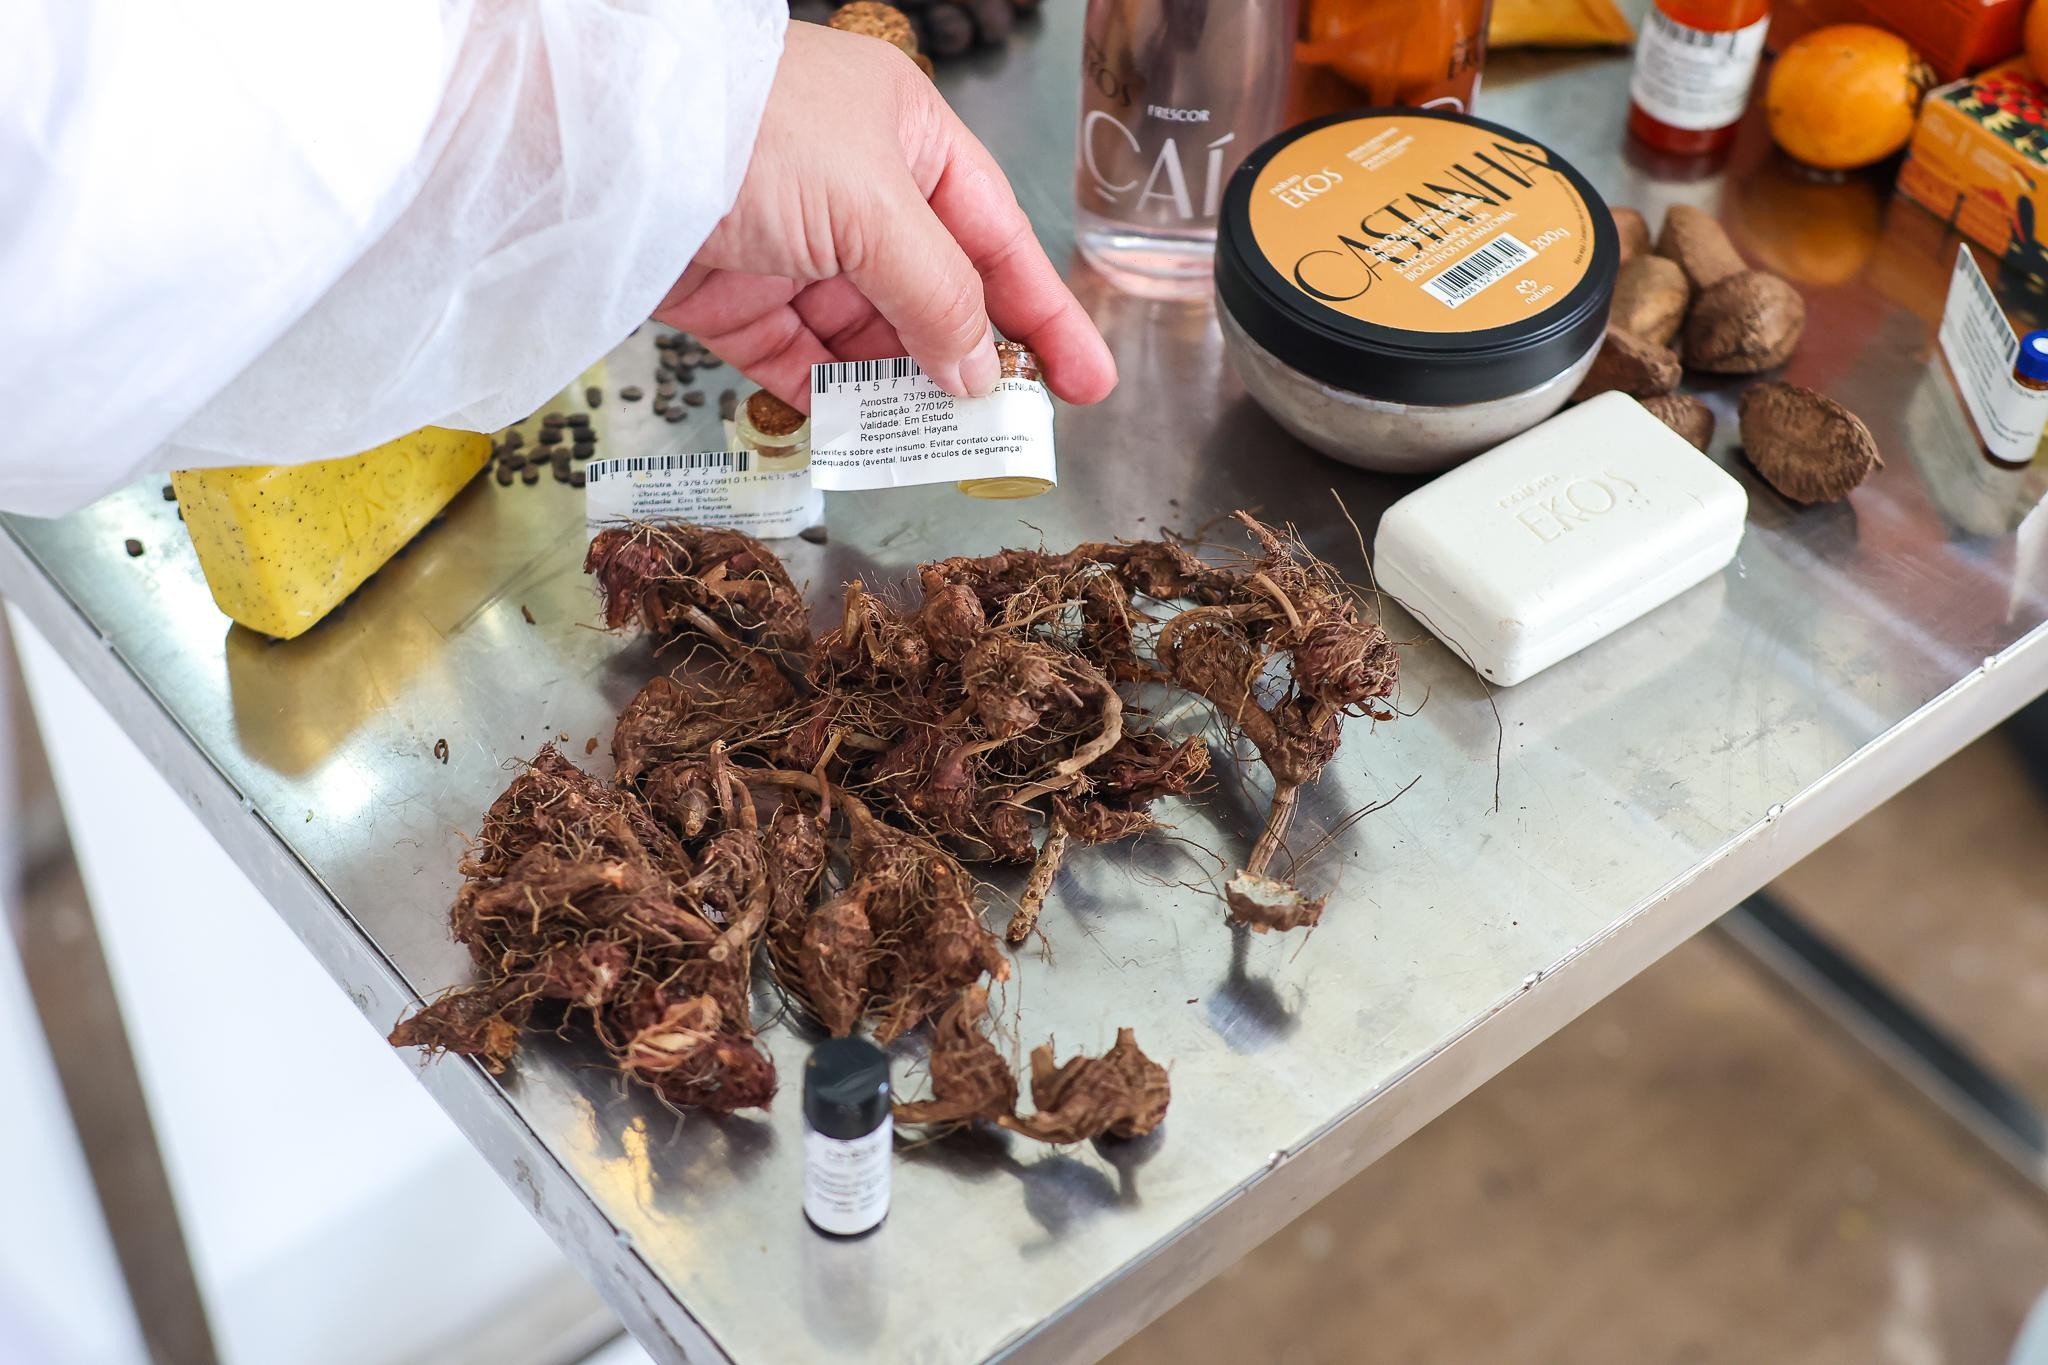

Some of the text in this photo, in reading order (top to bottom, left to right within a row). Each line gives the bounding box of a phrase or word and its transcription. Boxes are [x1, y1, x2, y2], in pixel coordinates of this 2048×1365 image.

[1147, 104, 1211, 122] FRESCOR
[1269, 174, 1303, 195] natura
[1278, 165, 1344, 209] EKOS
[1529, 226, 1571, 252] 200g
[1402, 244, 1461, 281] BIOACTIVOS
[1456, 275, 1493, 300] 908132
[1523, 283, 1554, 305] natura
[915, 401, 954, 413] 27/01/25
[904, 416, 919, 426] Em
[922, 412, 954, 423] Estudo
[924, 424, 958, 436] Hayana
[849, 447, 874, 457] sobre
[876, 446, 893, 455] este
[930, 440, 954, 449] Evitar
[957, 436, 988, 446] contato
[811, 458, 860, 469] adequados
[900, 453, 922, 463] luvas
[931, 449, 959, 459] óculos
[962, 447, 972, 456] de
[1515, 468, 1640, 544] EKOS
